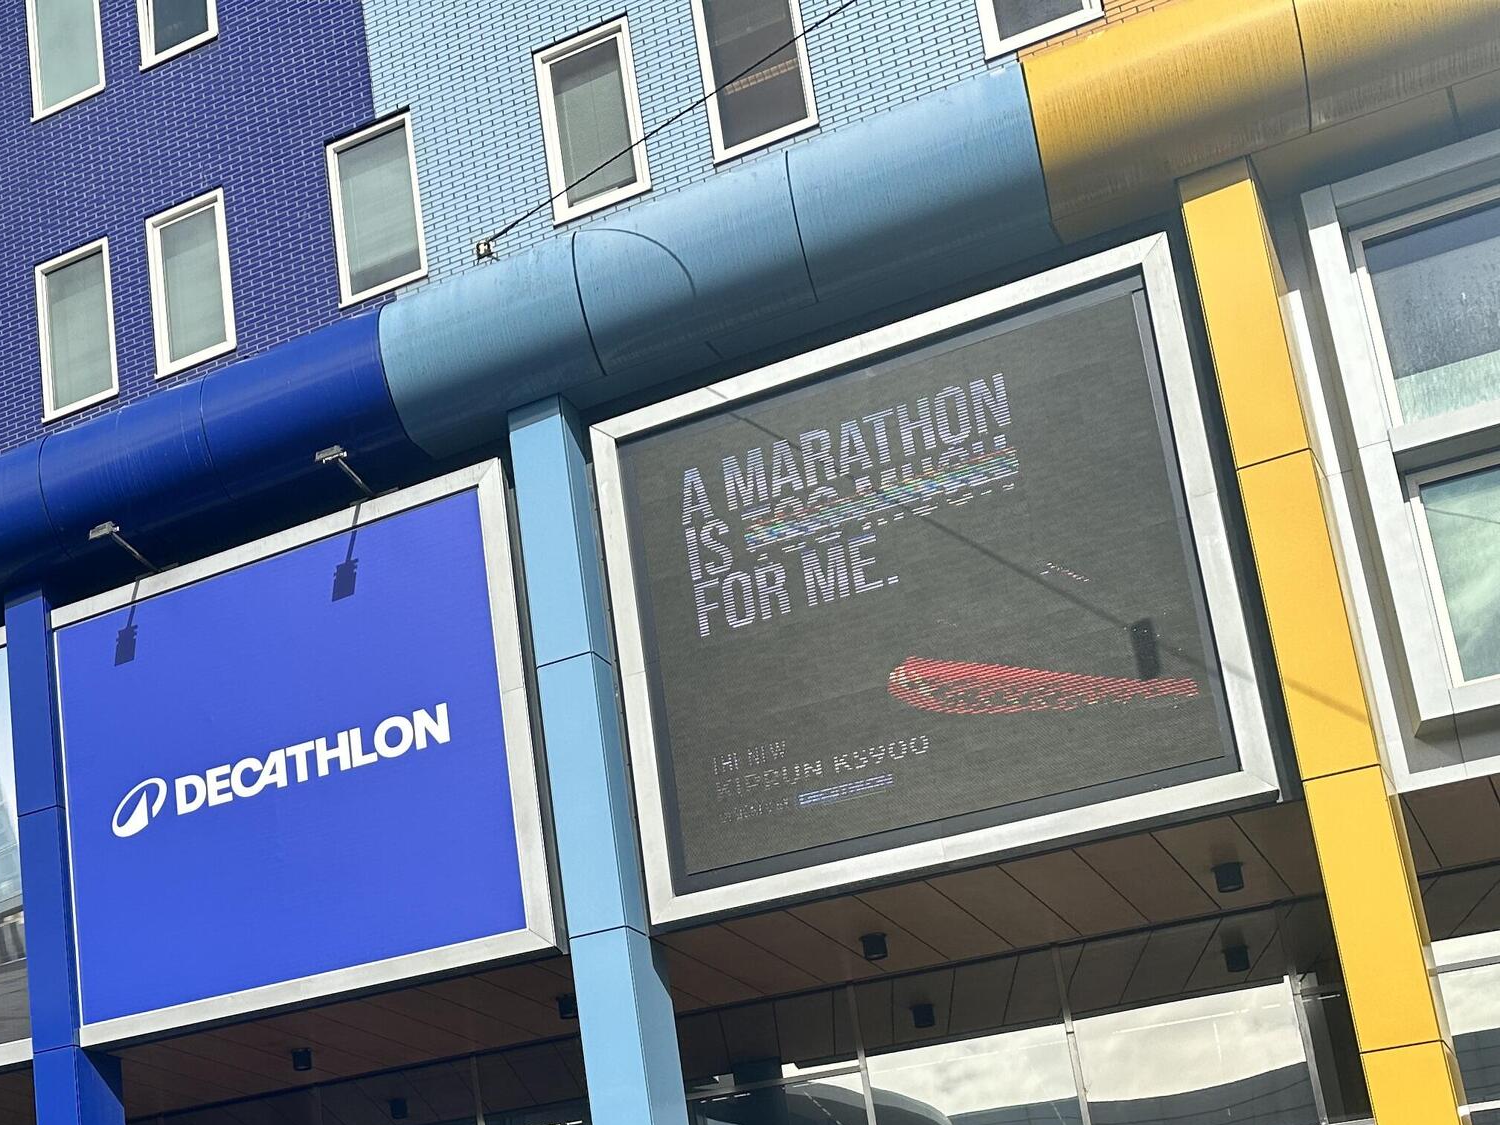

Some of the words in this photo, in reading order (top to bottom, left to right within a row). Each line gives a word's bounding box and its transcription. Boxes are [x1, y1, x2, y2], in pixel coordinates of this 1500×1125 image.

[682, 467, 715, 525] A
[721, 373, 1012, 512] MARATHON
[685, 519, 733, 581] IS
[693, 562, 792, 638] FOR
[800, 533, 899, 607] ME.
[174, 702, 450, 816] DECATHLON
